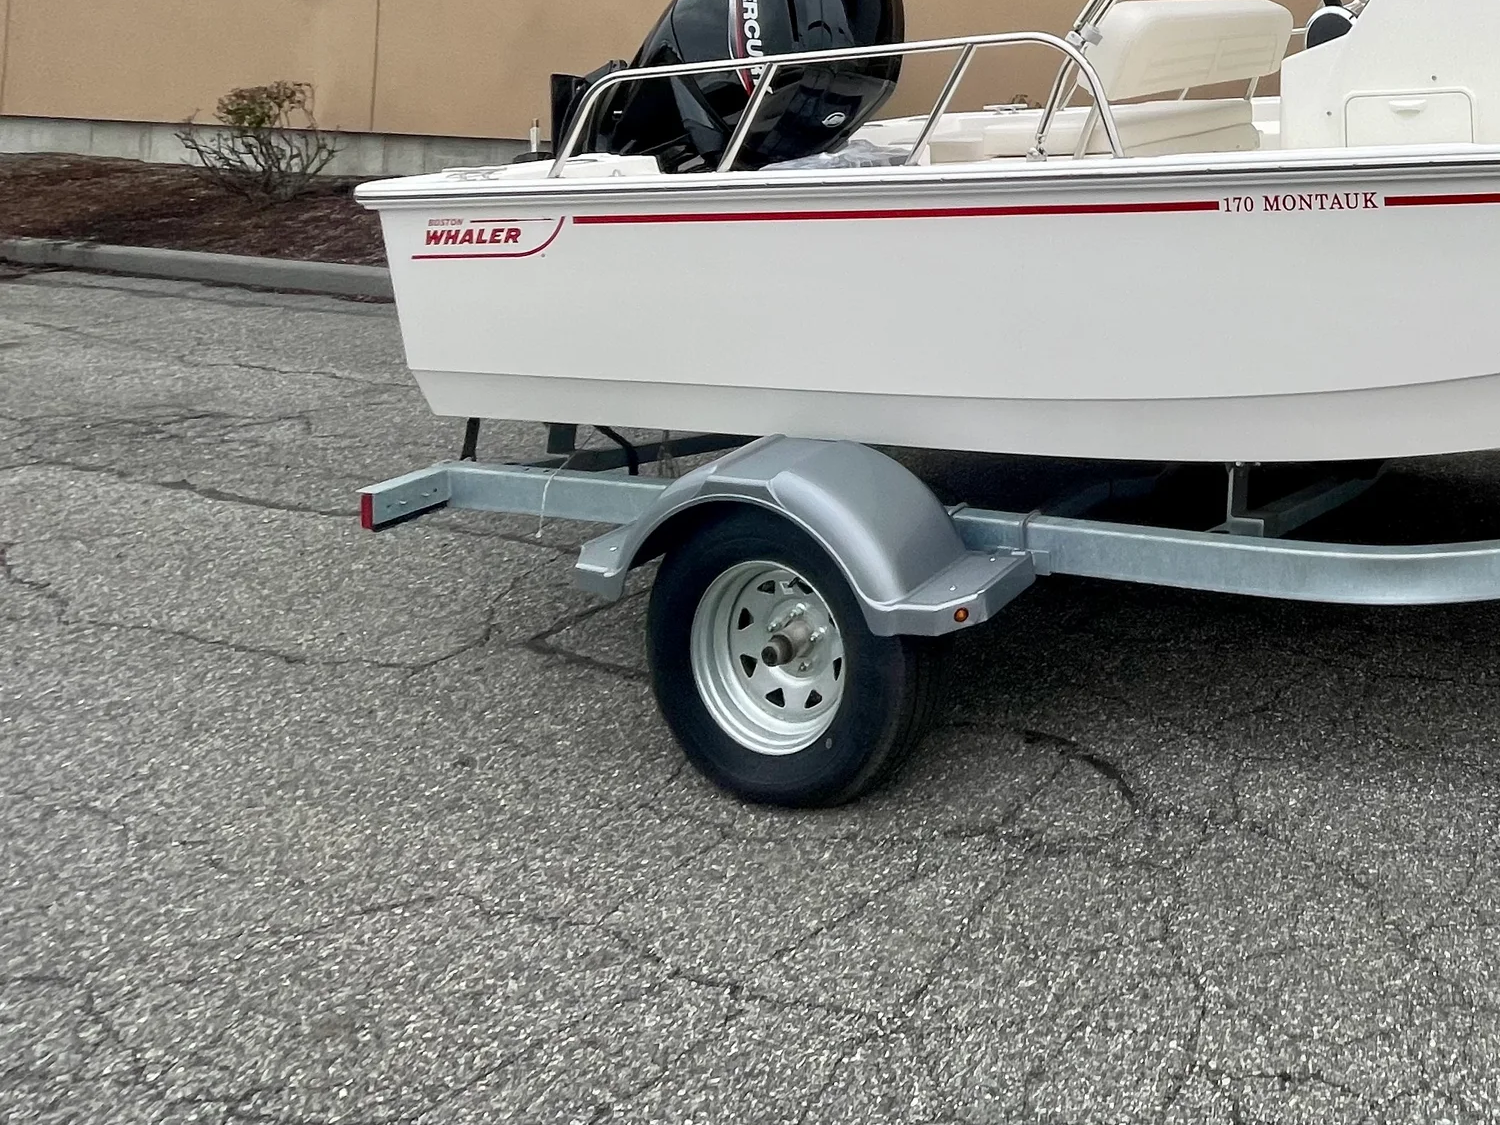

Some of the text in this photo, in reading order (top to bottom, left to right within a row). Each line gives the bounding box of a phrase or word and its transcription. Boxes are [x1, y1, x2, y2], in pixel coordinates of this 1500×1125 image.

[1223, 192, 1379, 213] 170 MONTAUK
[427, 218, 464, 227] BOSTON
[425, 227, 522, 246] WHALER
